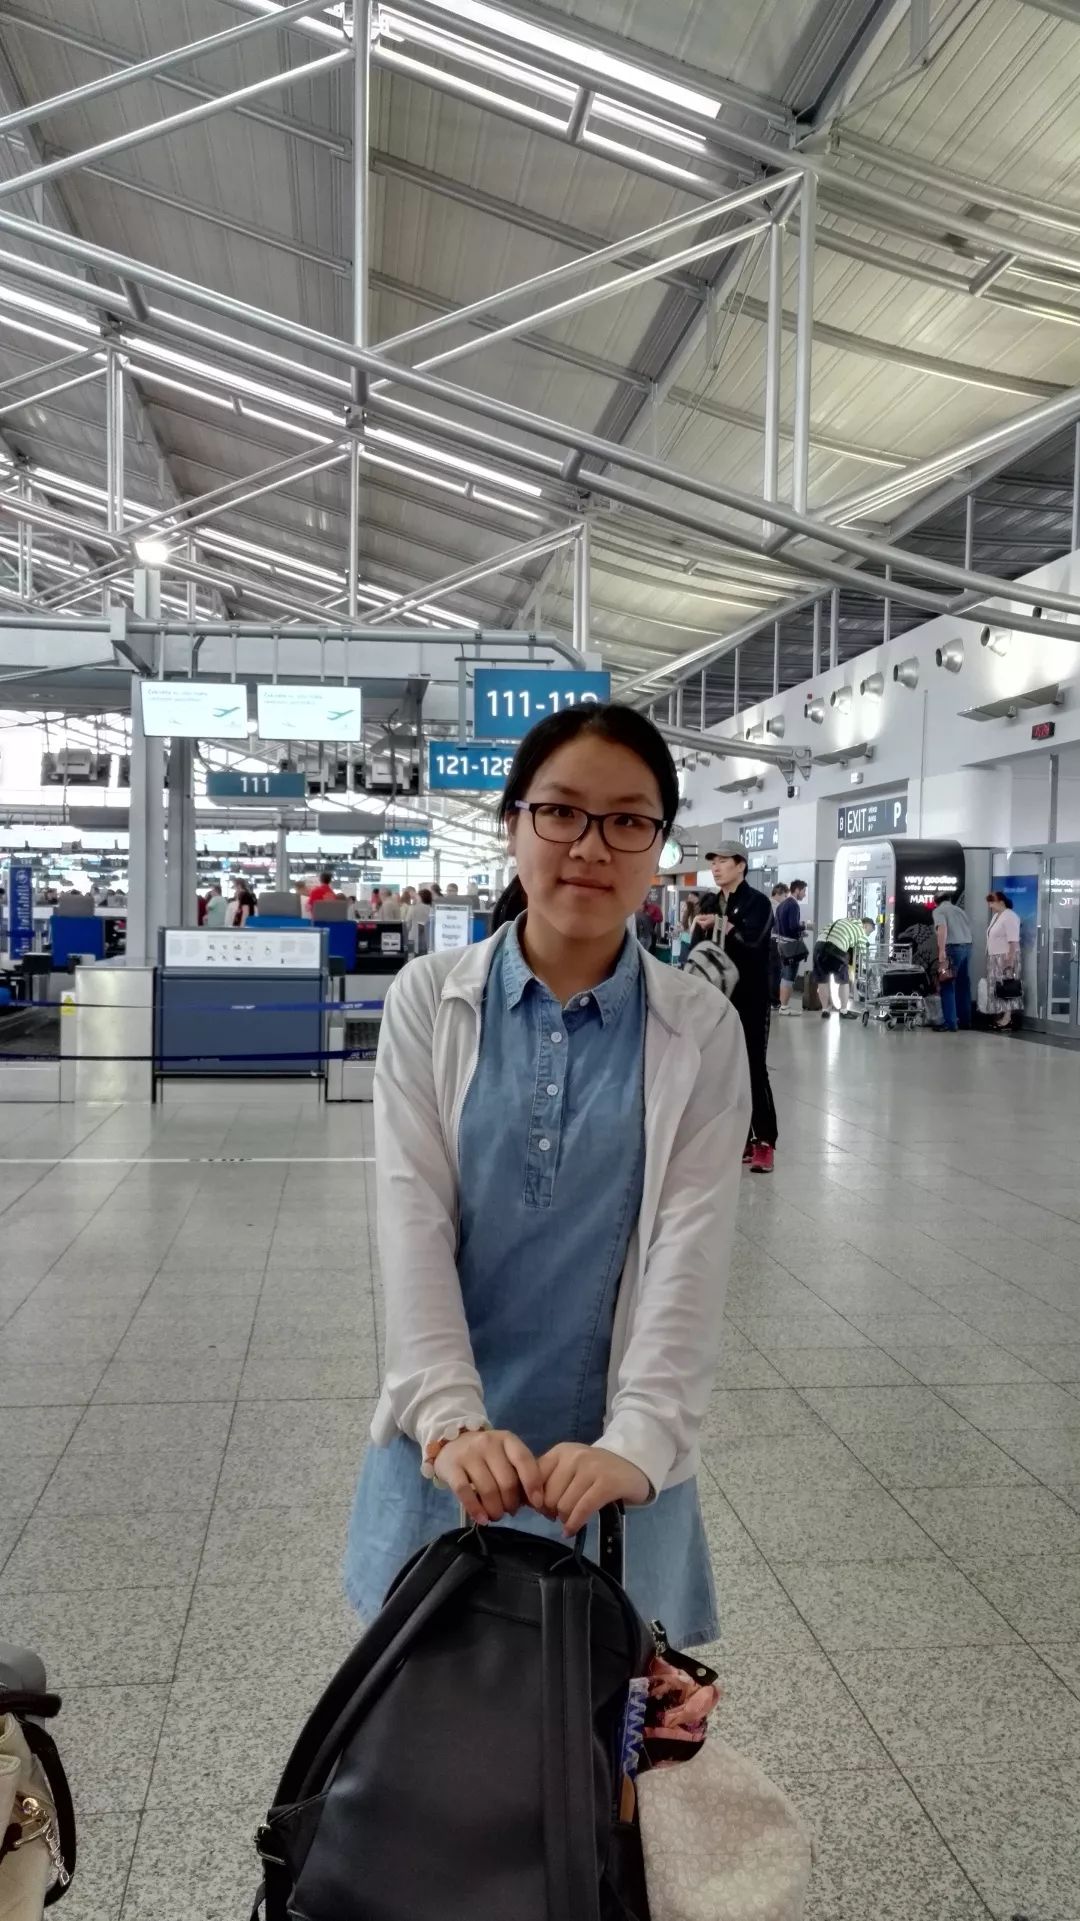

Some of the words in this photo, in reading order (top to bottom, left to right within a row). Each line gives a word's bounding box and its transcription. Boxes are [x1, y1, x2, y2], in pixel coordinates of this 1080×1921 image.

[436, 755, 514, 776] 121-128
[240, 776, 270, 794] 111
[847, 807, 867, 834] EXIT
[893, 801, 902, 828] P
[388, 835, 428, 847] 131-138
[904, 875, 923, 885] very
[924, 875, 957, 885] goodies
[909, 894, 935, 904] MATT
